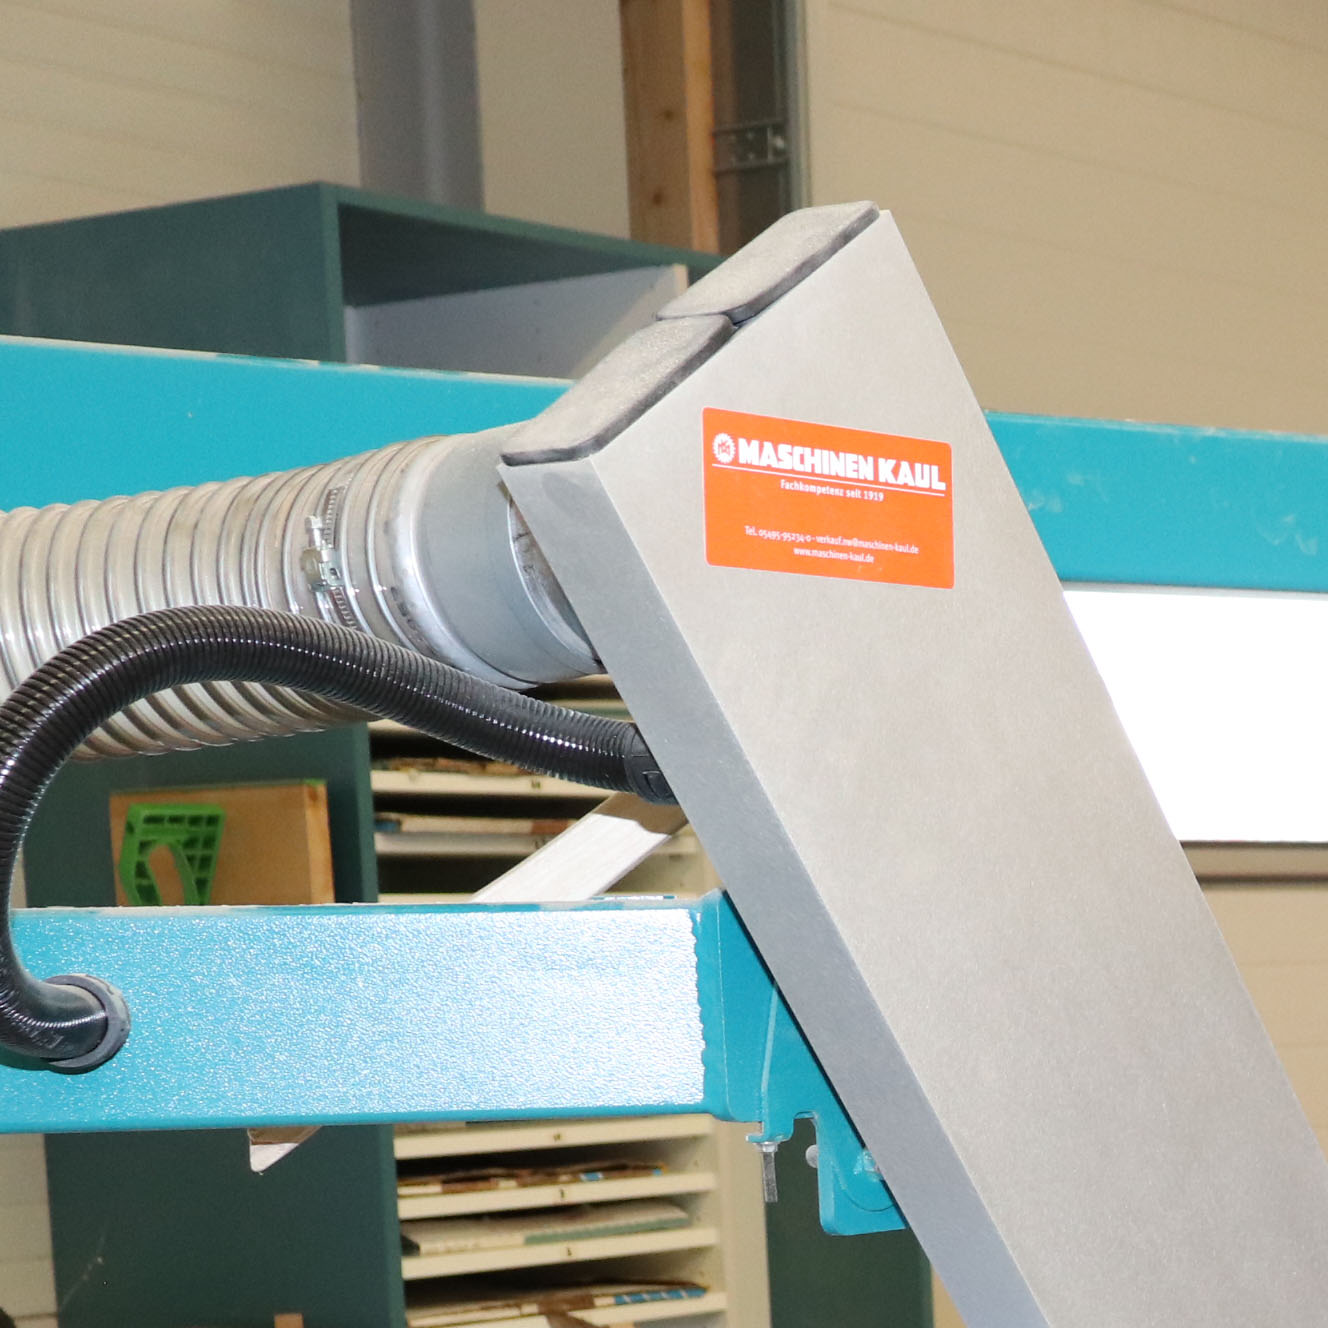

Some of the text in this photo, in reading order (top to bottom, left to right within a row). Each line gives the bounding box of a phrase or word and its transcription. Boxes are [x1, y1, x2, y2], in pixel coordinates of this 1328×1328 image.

[738, 438, 947, 490] MASCHINEN KAUL
[780, 479, 884, 502] Fachkompetenz seit 1919
[744, 525, 758, 536] Tel.
[793, 547, 875, 564] www.maschinen-kaul.de
